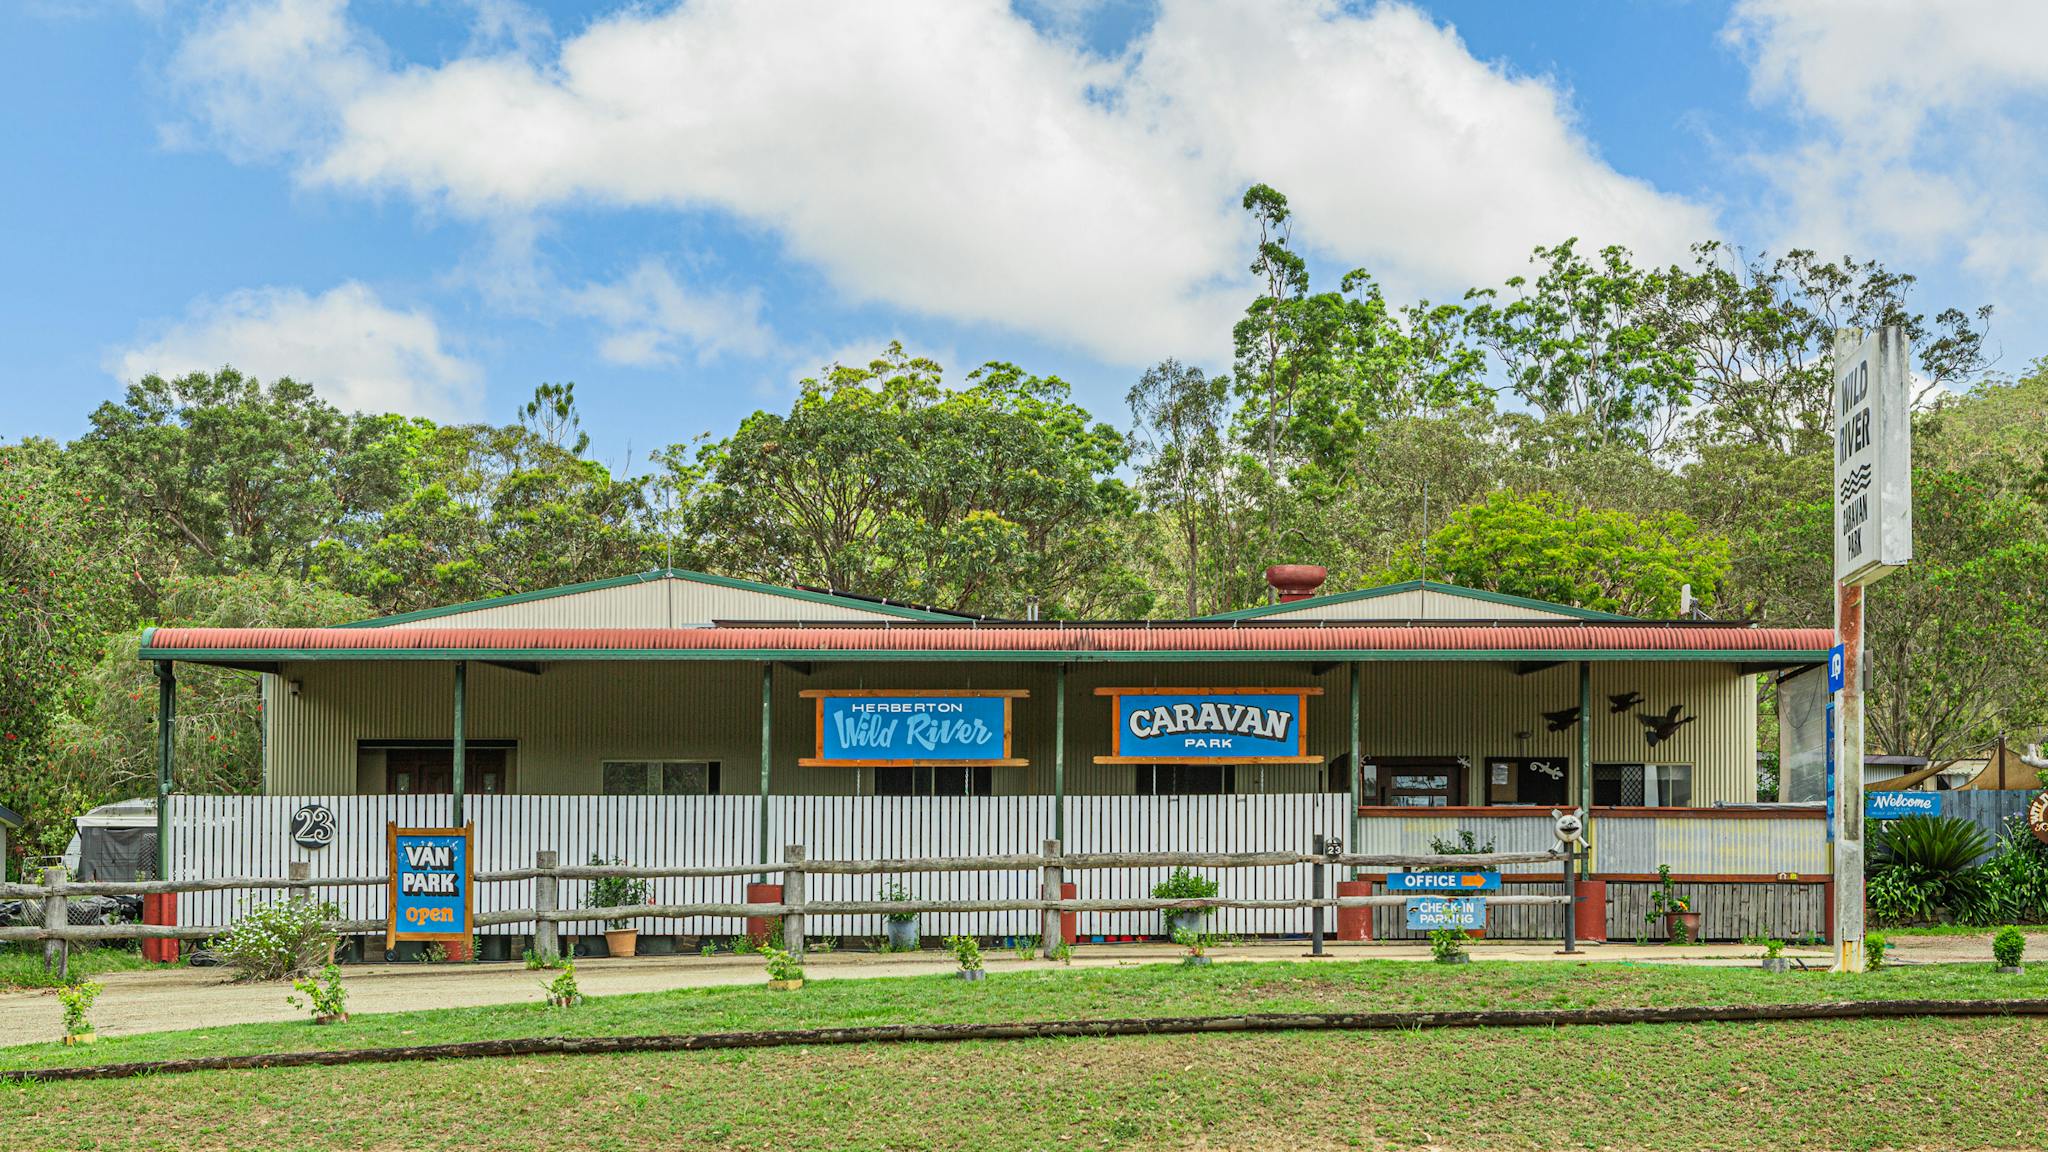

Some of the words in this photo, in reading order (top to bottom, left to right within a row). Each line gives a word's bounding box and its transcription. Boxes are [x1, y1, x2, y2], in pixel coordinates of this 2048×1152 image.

[1842, 360, 1868, 417] WILD
[1840, 407, 1870, 466] RIVER
[1843, 493, 1868, 536] CARAVAN
[1848, 528, 1863, 562] PARK
[852, 703, 963, 713] HERBERTON
[833, 710, 898, 749] Wild
[907, 713, 993, 751] River
[1129, 702, 1292, 741] CARAVAN
[1184, 738, 1233, 748] PARK
[1873, 793, 1932, 808] Welcome
[295, 808, 337, 843] 23
[404, 846, 453, 869] VAN
[1328, 846, 1341, 855] 23
[402, 872, 458, 895] PARK
[1404, 875, 1456, 887] OFFICE
[406, 907, 454, 925] Open
[1420, 902, 1474, 913] CHECK-IN
